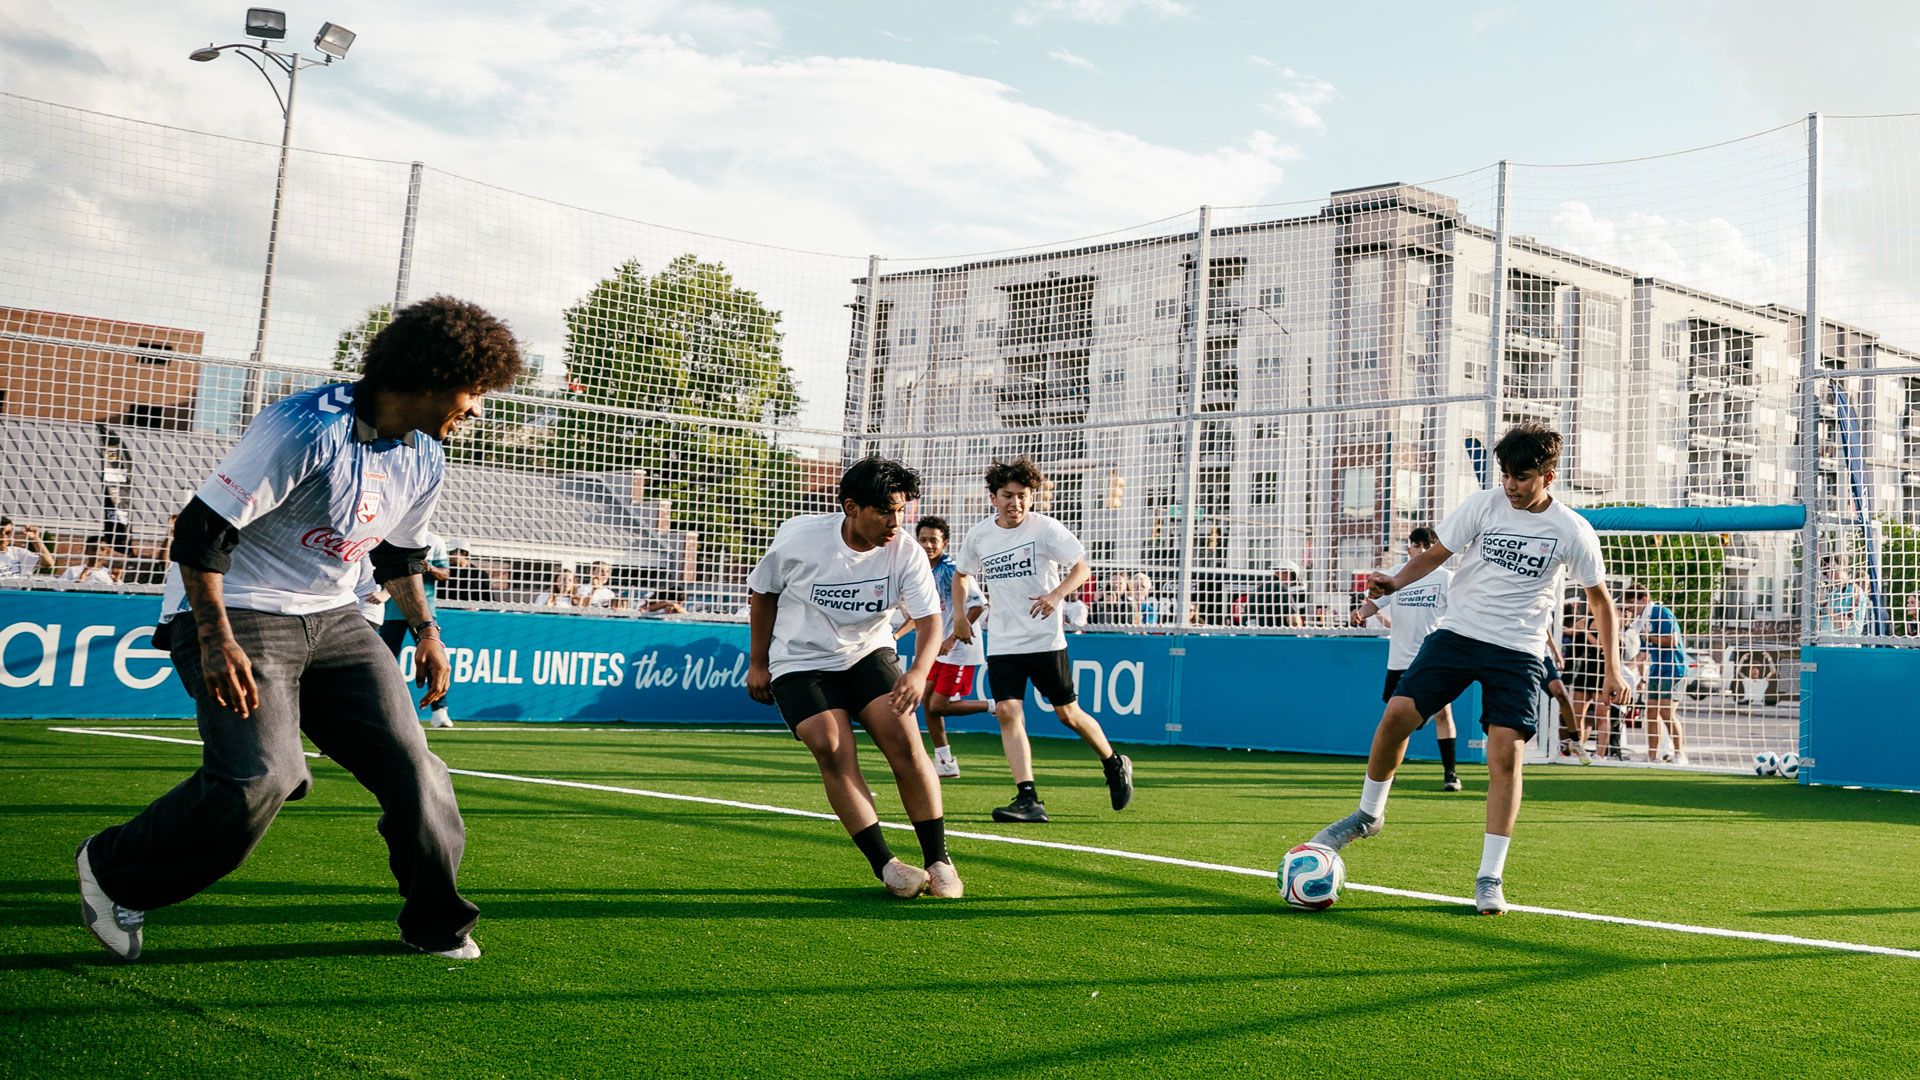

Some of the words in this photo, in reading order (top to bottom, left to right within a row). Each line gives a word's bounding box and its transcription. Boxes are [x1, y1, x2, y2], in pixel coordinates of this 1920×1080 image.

[1483, 537, 1527, 550] soccer
[984, 552, 1015, 567] occer
[984, 558, 1032, 574] orward
[815, 588, 860, 599] soccer
[813, 596, 884, 613] forward
[0, 621, 173, 690] are
[400, 645, 523, 684] OTBALL
[532, 650, 625, 687] UNITES
[632, 650, 678, 690] the
